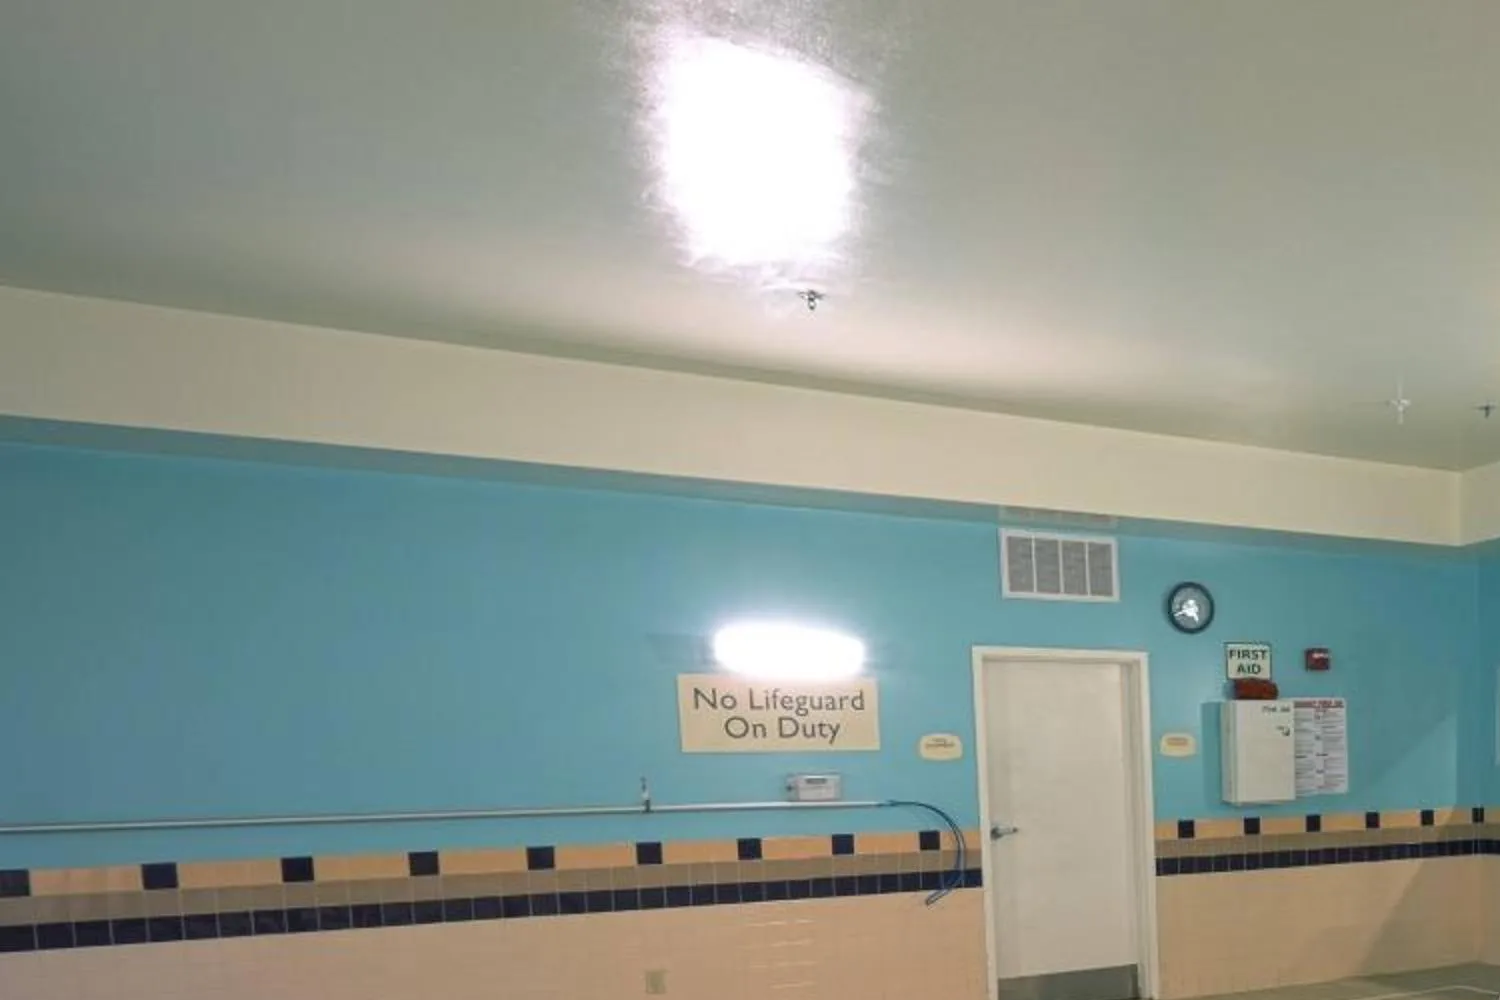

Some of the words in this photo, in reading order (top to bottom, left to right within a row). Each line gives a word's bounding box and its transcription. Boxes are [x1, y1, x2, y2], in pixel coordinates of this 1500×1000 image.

[1229, 649, 1267, 660] FIRST
[1237, 663, 1261, 675] AID
[693, 687, 737, 710] No
[749, 688, 865, 716] Lifeguard
[725, 716, 767, 739] On
[778, 717, 841, 744] Duty
